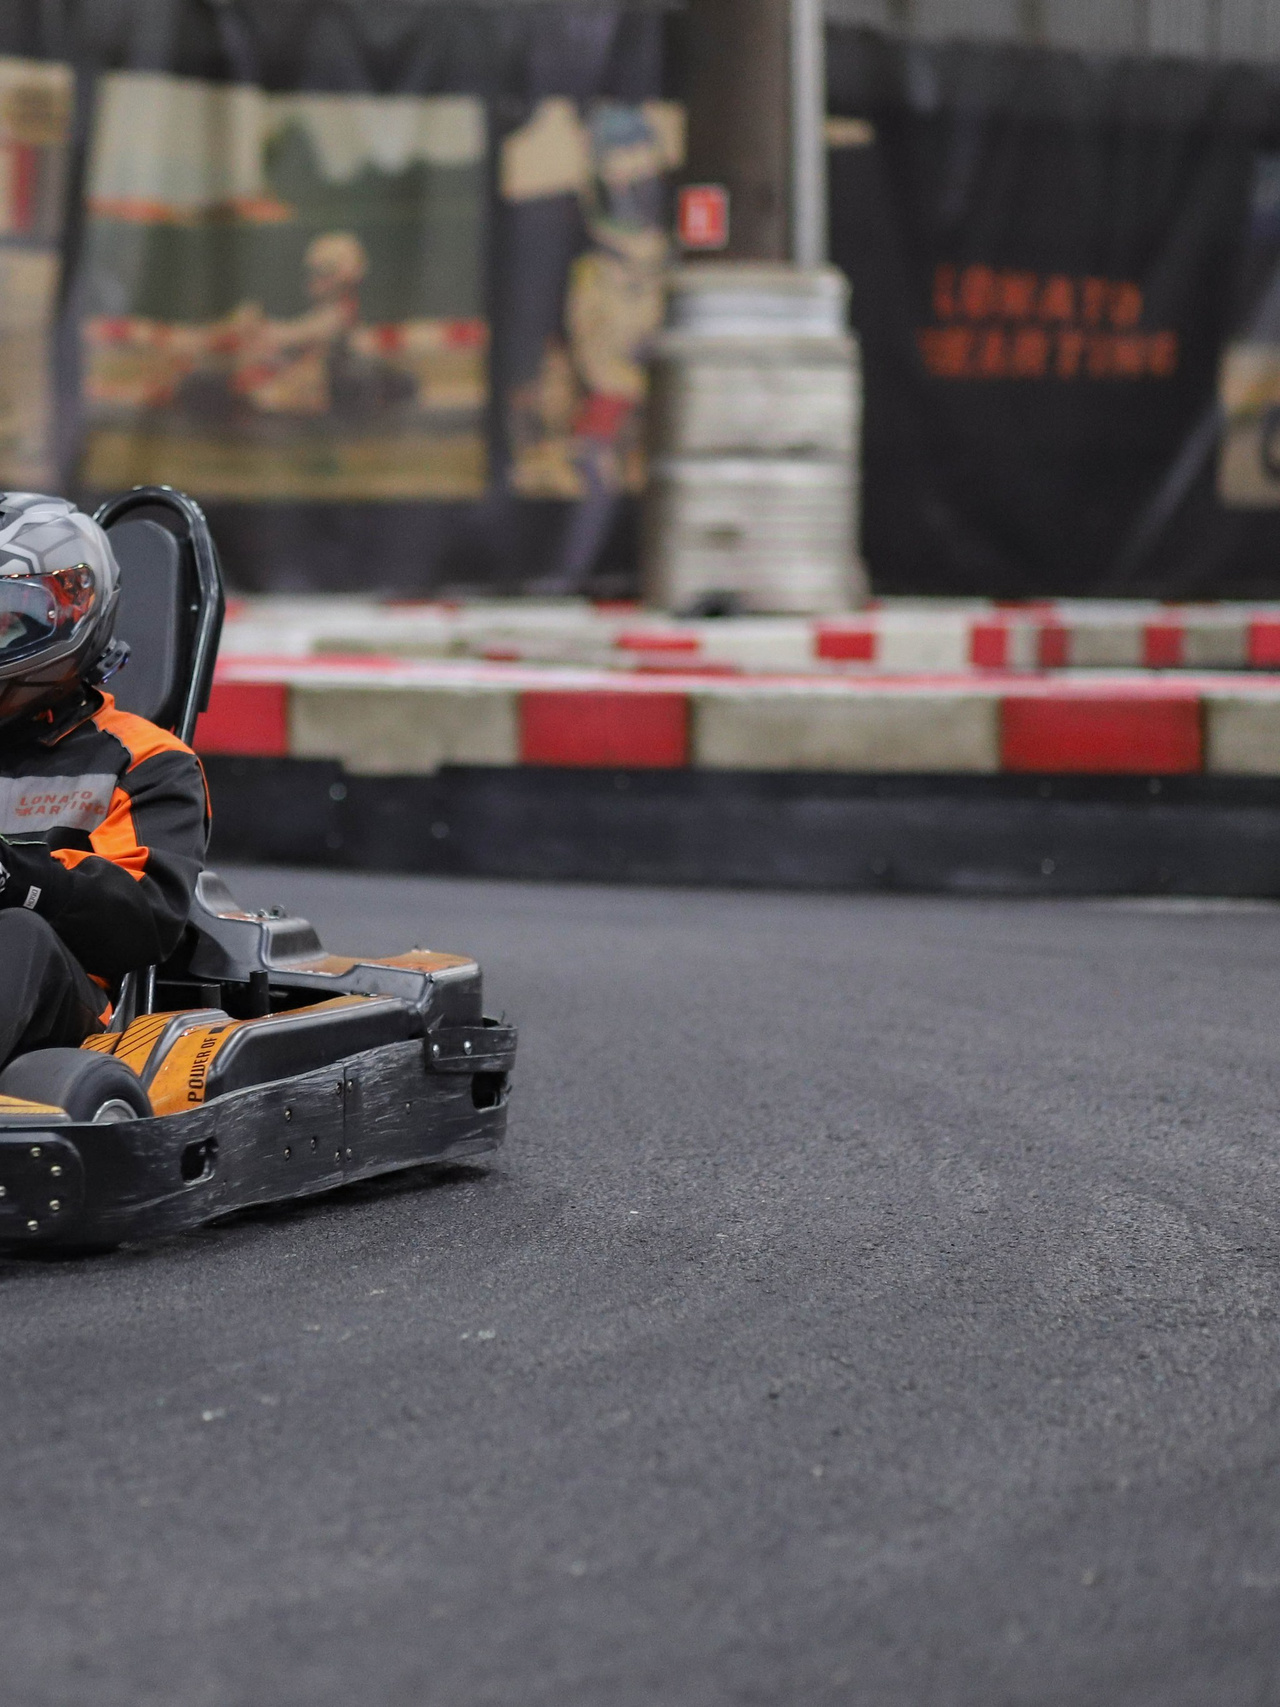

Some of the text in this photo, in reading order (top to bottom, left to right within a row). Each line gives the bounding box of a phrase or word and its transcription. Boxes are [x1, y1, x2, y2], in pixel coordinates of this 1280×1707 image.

[20, 791, 93, 806] LONATO
[187, 1037, 218, 1103] POWER OF
